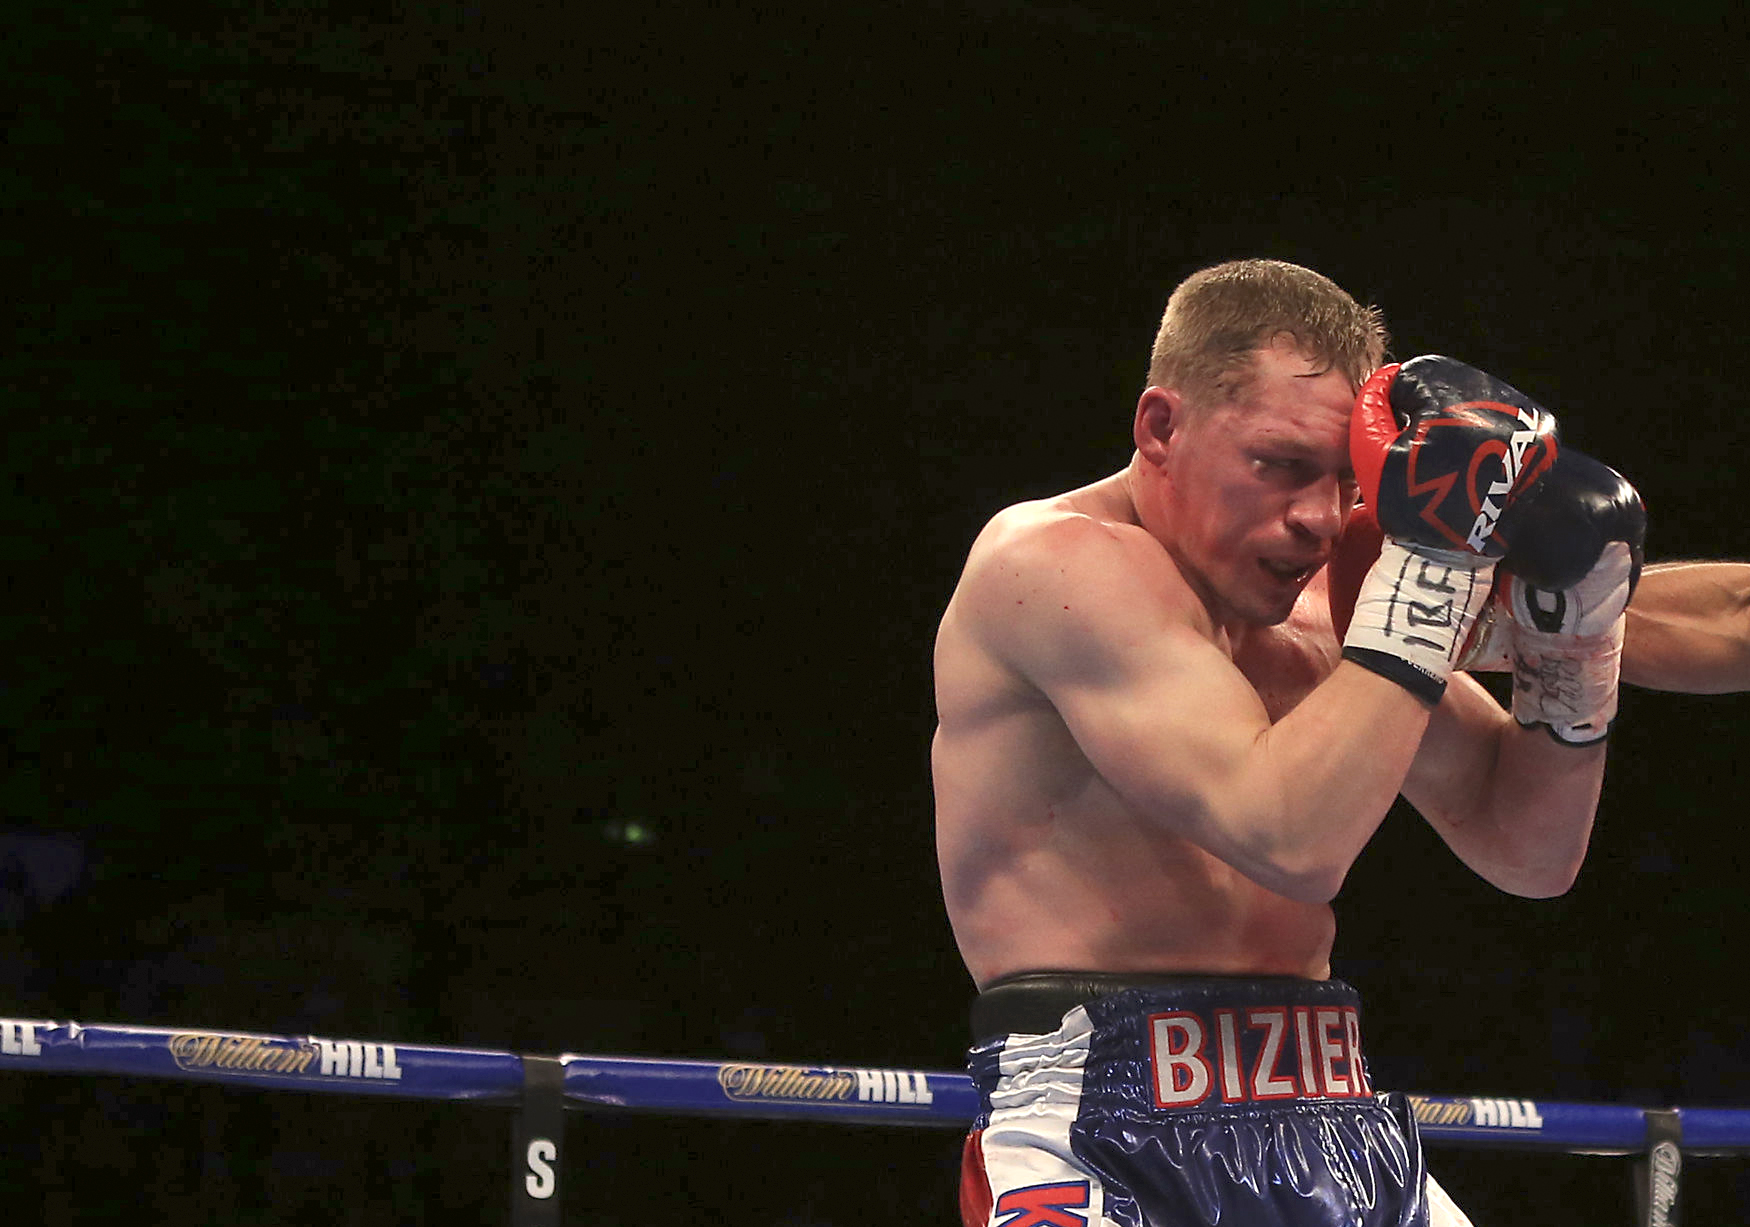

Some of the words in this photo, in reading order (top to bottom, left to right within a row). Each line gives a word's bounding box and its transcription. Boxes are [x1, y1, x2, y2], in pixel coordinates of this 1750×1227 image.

[1466, 408, 1538, 553] RIVAL
[0, 1022, 42, 1056] LL
[169, 1031, 319, 1073] William
[317, 1038, 402, 1080] HILL
[1149, 1005, 1373, 1108] BIZIER
[717, 1064, 860, 1102] William
[856, 1069, 933, 1104] HILL
[1472, 1098, 1543, 1129] HILL
